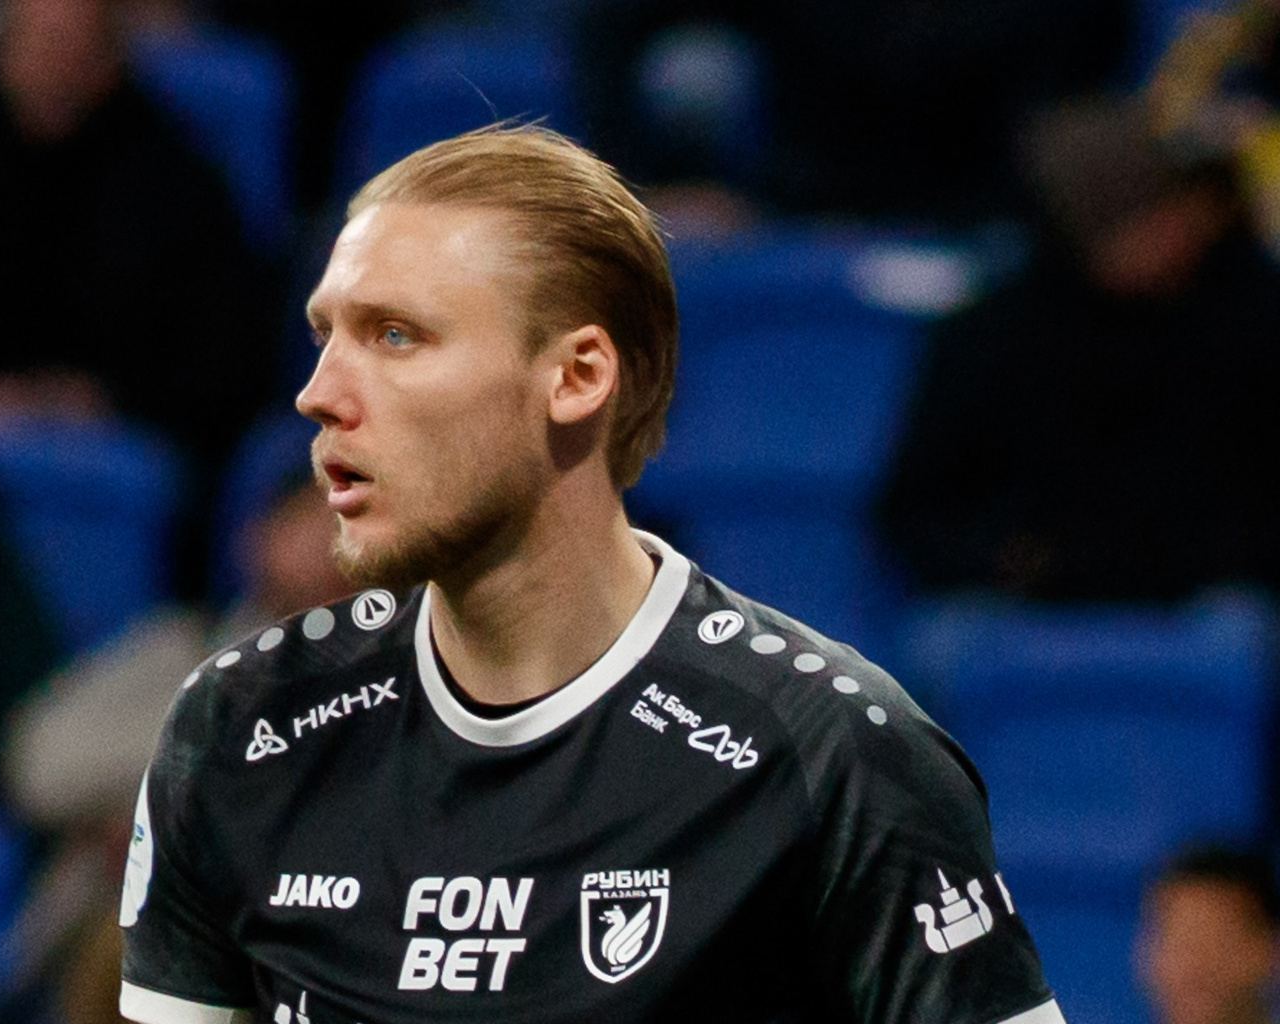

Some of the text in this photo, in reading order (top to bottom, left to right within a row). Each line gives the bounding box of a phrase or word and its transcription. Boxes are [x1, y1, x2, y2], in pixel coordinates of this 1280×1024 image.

[293, 676, 399, 738] НКНХ
[630, 700, 669, 734] Банк
[642, 683, 702, 728] Ак Барс
[269, 874, 360, 909] JAKO
[582, 869, 670, 889] РУБИН
[603, 890, 648, 898] КАЗАНЬ
[403, 876, 534, 930] FON
[398, 938, 526, 991] BET
